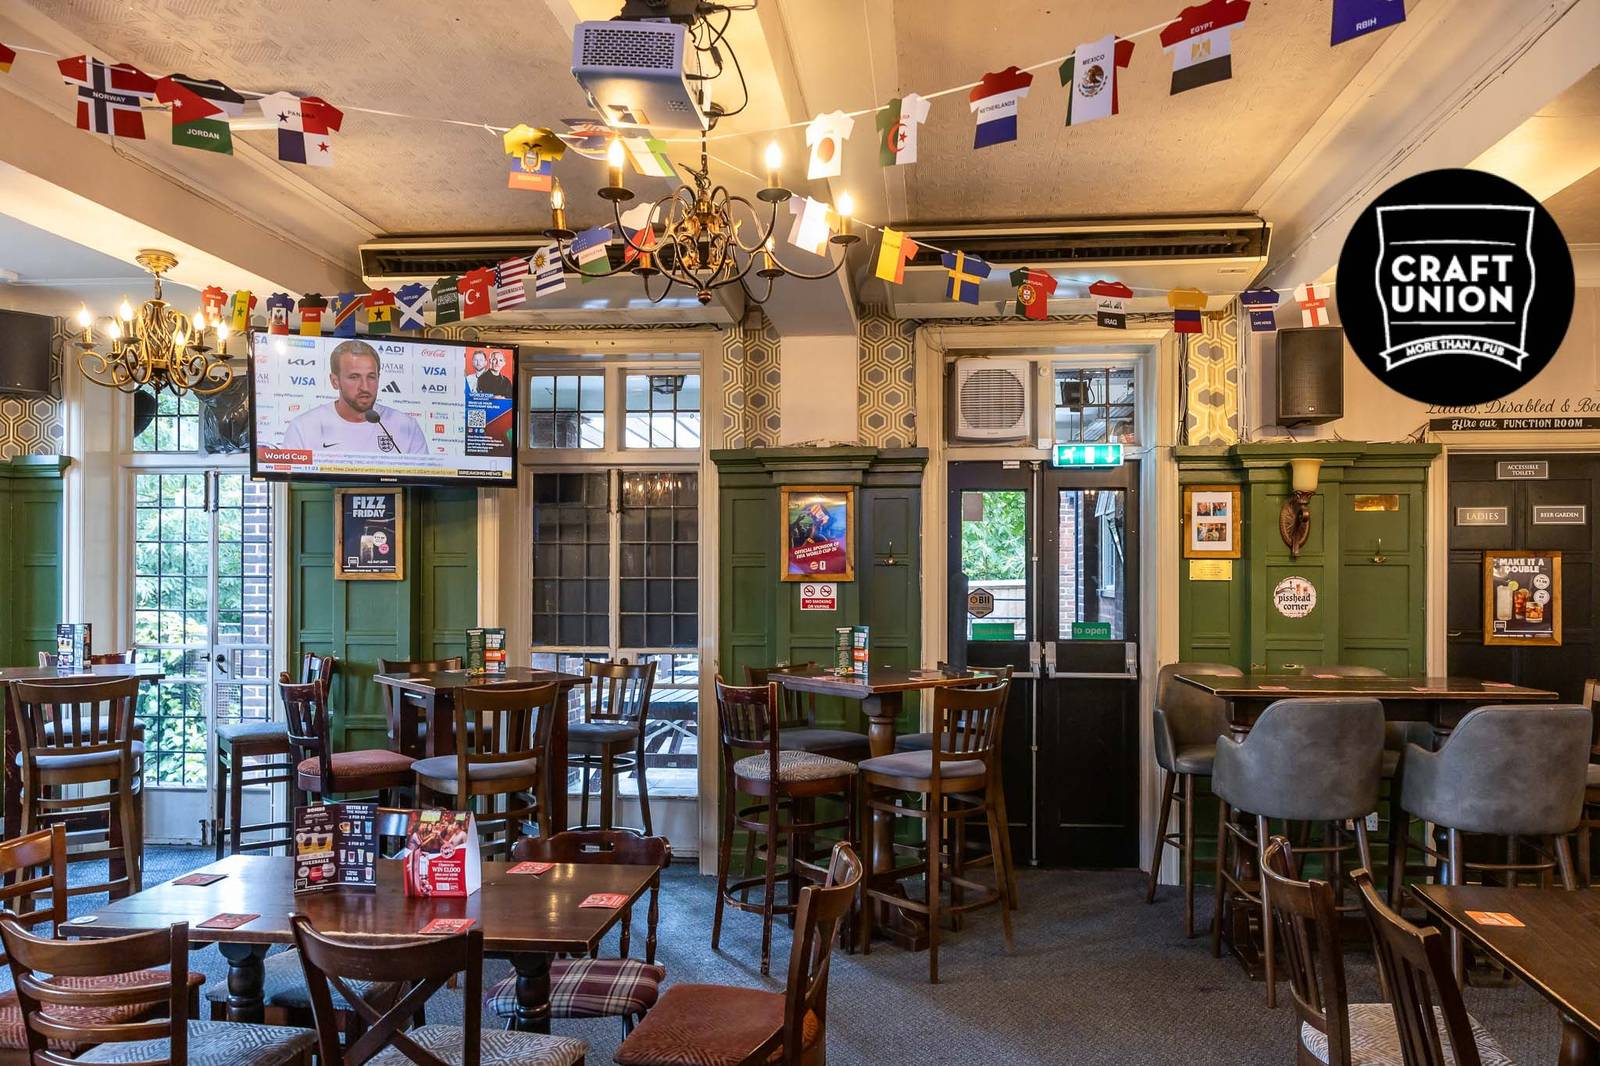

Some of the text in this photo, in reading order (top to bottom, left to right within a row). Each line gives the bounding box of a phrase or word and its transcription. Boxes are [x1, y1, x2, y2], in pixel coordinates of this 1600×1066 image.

[1190, 21, 1214, 34] EGYPT
[1356, 17, 1377, 31] RBIH
[1082, 54, 1105, 65] MEXICO
[92, 91, 126, 103] NORWAY
[980, 100, 1015, 113] NETHERLANDS
[186, 128, 220, 140] JORDAN
[1104, 318, 1118, 326] IRAQ
[385, 345, 404, 353] ADI
[423, 367, 447, 376] VISA
[291, 376, 316, 386] VISA
[428, 384, 447, 392] ADI
[1485, 399, 1556, 414] Disabled
[1560, 399, 1570, 413] &
[1452, 419, 1583, 430] Hire our FUNCTION ROOM
[264, 452, 290, 460] World
[291, 453, 308, 461] Cup
[352, 496, 386, 509] FIZZ
[352, 510, 386, 518] FRIDAY
[1466, 512, 1499, 520] LADIES
[794, 546, 813, 555] OFFICIAL
[813, 542, 833, 551] SPONSOR
[806, 550, 822, 558] WORLD
[1499, 558, 1525, 566] MAKE
[978, 596, 990, 604] BII
[1278, 593, 1311, 604] pisshead
[1085, 627, 1107, 635] open
